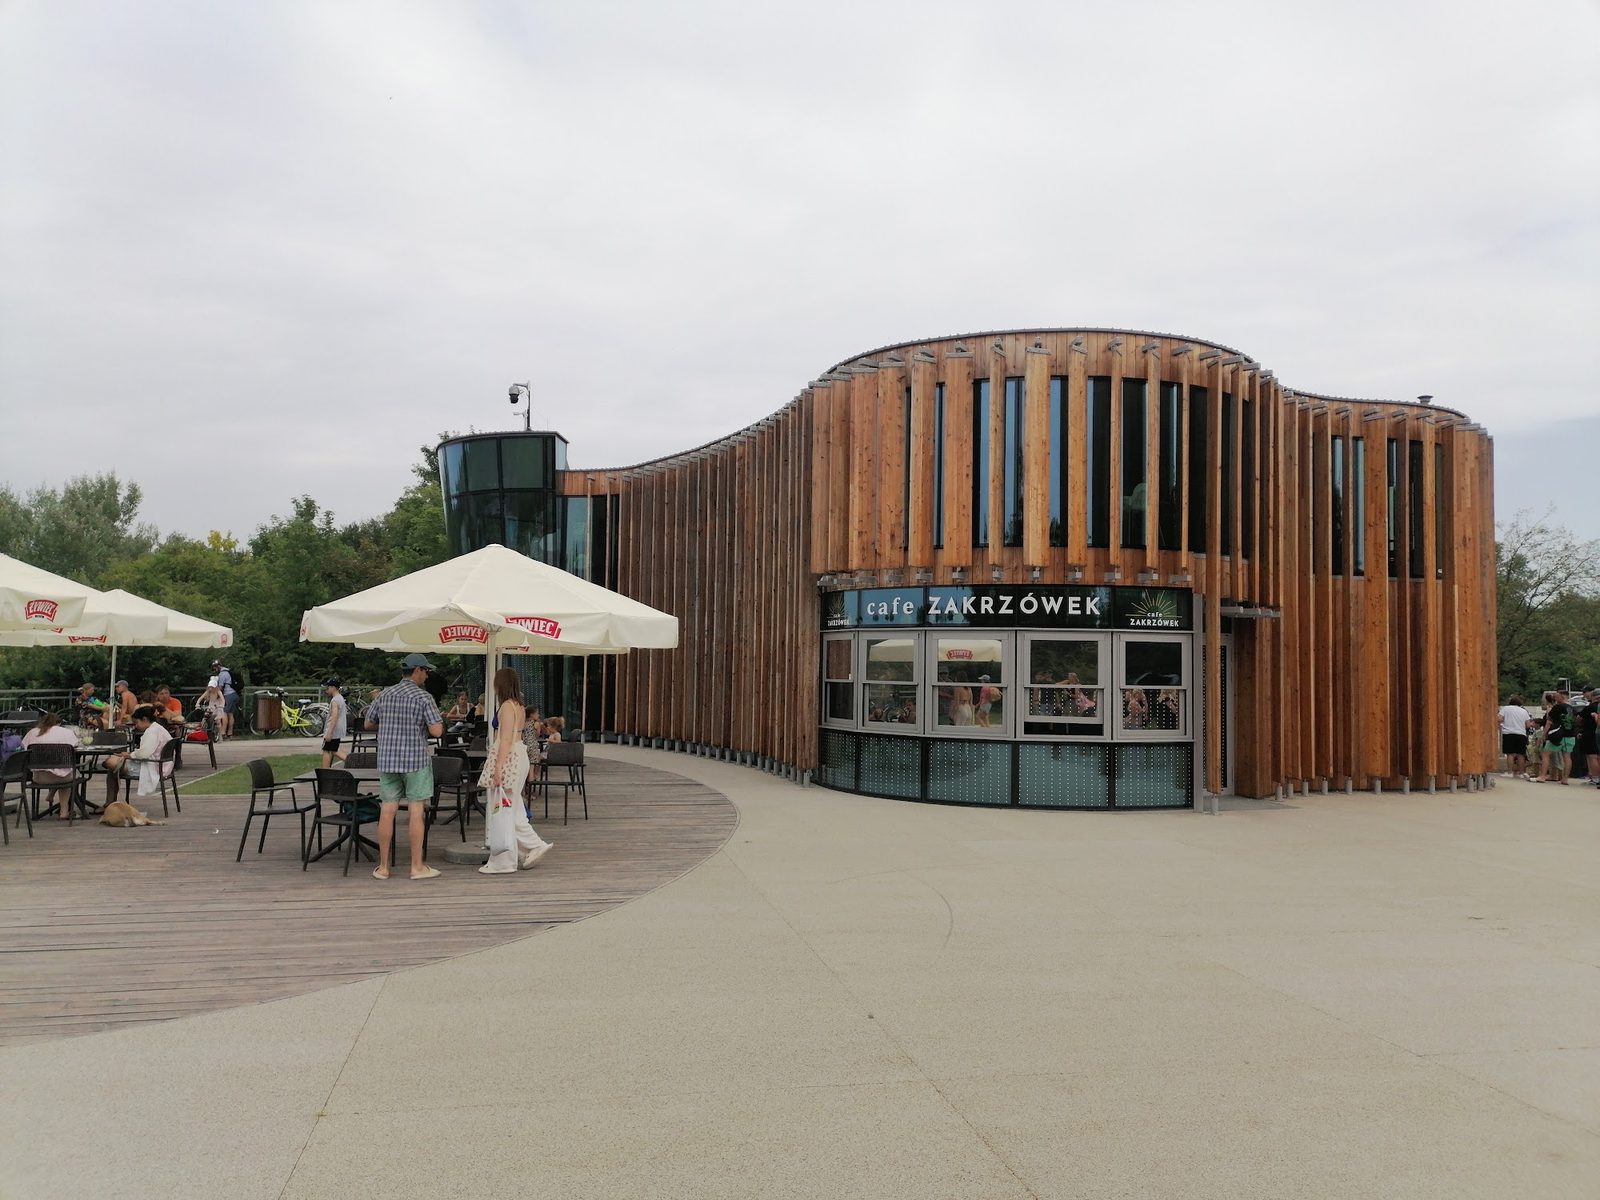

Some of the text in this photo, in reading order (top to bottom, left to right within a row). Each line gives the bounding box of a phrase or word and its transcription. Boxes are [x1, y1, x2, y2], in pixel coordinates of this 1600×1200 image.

[867, 593, 1101, 615] cafe ZAKRZÓWEK
[1130, 618, 1179, 627] ZAKRZÓWEK
